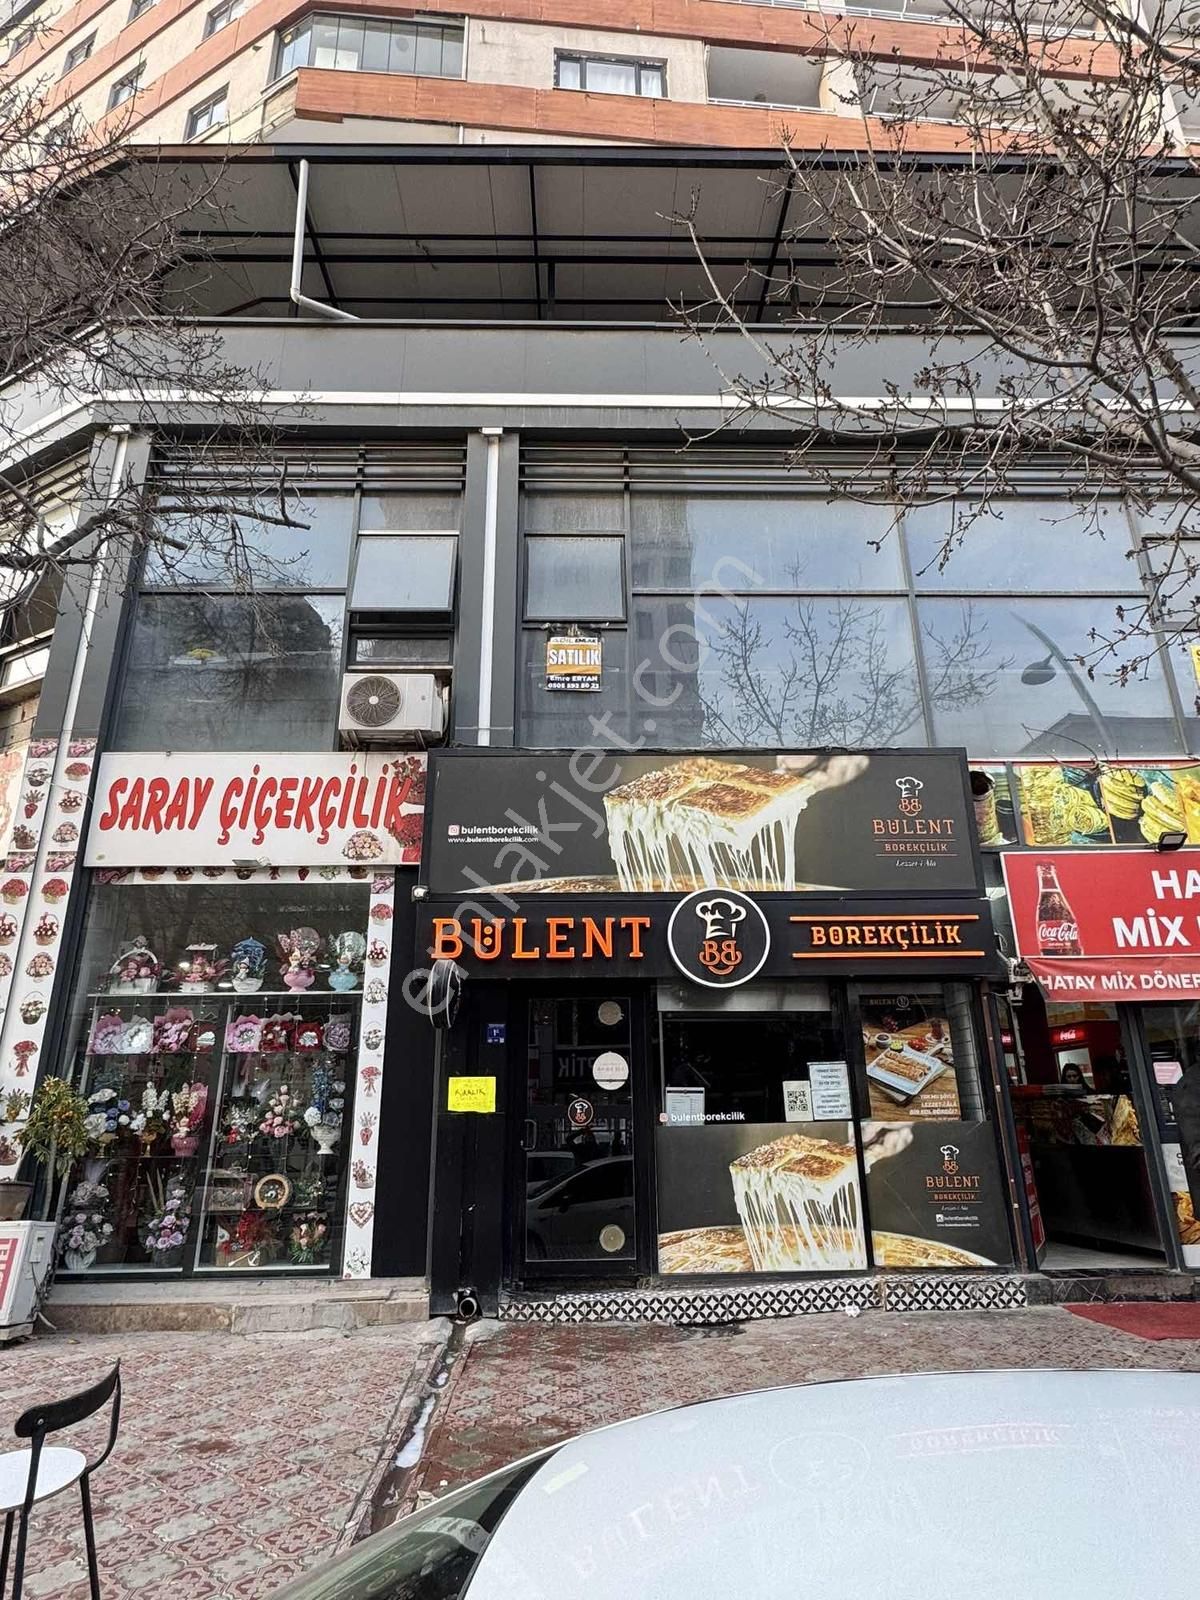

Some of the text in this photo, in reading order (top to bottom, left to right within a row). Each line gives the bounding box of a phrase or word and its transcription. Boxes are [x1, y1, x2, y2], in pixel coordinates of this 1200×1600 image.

[549, 649, 600, 665] SATILIK
[99, 763, 412, 845] SARAY ÇİÇEKÇİLİK
[461, 825, 539, 835] bulentborekcilik
[1112, 908, 1192, 948] MİX
[431, 917, 650, 960] BÜLENT
[1037, 974, 1097, 990] HATAY
[1101, 970, 1138, 990] MİX
[671, 1111, 746, 1122] bulentborekcilik
